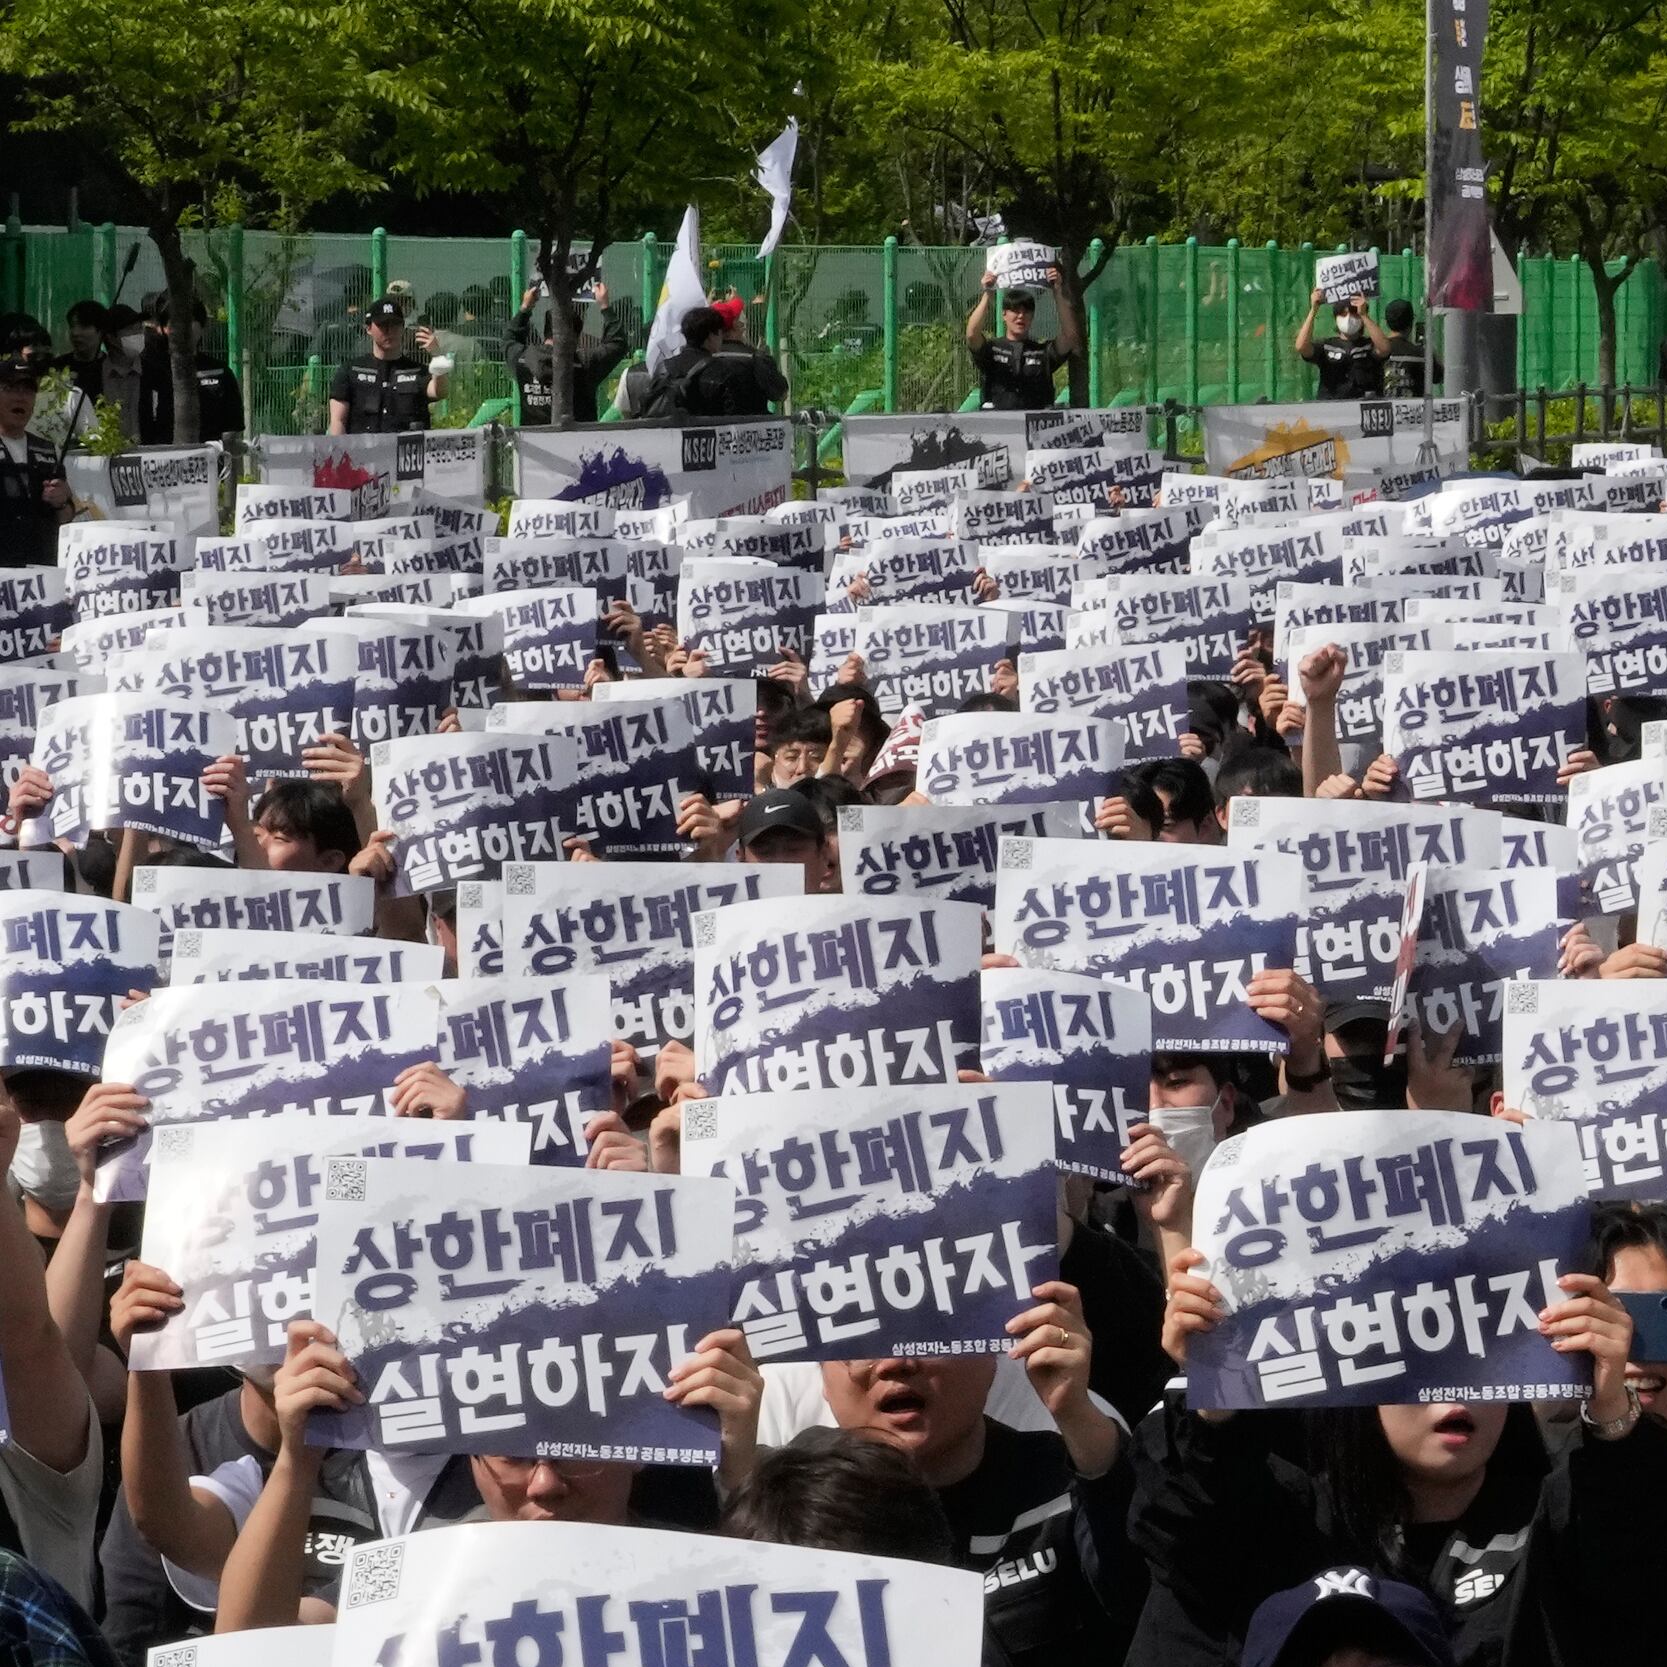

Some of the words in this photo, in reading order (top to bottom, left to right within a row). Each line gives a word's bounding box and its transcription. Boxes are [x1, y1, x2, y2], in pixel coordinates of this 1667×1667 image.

[1361, 404, 1393, 435] NSEU
[683, 432, 715, 470] NSEU
[111, 459, 144, 499] NSEU
[1380, 467, 1440, 494] 상한폐지
[963, 500, 1048, 538] 상한폐지
[74, 536, 177, 582] 상한폐지
[492, 545, 608, 593] 상한폐지
[867, 543, 967, 583] 상한폐지
[1214, 531, 1325, 576] 상한폐지
[689, 574, 800, 615] 상한폐지
[1113, 582, 1230, 633] 상한폐지
[698, 629, 812, 667] 실현하자
[865, 616, 986, 661] 상한폐지
[157, 640, 328, 694] 상한폐지
[874, 662, 993, 712] 실현하자
[1029, 652, 1164, 712] 상한폐지
[1394, 659, 1559, 731] 상한폐지
[386, 741, 552, 819] 상한폐지
[925, 726, 1101, 794] 상한폐지
[1406, 730, 1577, 800] 실현하자
[402, 814, 575, 890] 실현하자
[1013, 860, 1260, 949] 상한폐지
[706, 909, 941, 1031] 상한폐지
[134, 995, 394, 1097] 상한폐지
[1155, 1038, 1225, 1052] 삼성전자노동조합
[1227, 1039, 1287, 1054] 공동투쟁본부
[711, 1097, 1006, 1237] 상한폐지
[1217, 1131, 1537, 1270] 상한폐지
[342, 1189, 677, 1312] 상한폐지
[732, 1221, 1055, 1361] 실현하자
[892, 1341, 988, 1358] 삼성전자노동조합
[1249, 1259, 1559, 1403] 실현하자
[369, 1324, 695, 1447] 실현하자
[1418, 1385, 1520, 1403] 삼성전자노동조합
[1522, 1384, 1594, 1401] 공동투쟁본부
[536, 1441, 638, 1462] 삼성전자노동조합
[639, 1444, 718, 1465] 공동투쟁본부
[984, 1548, 1057, 1594] SELU
